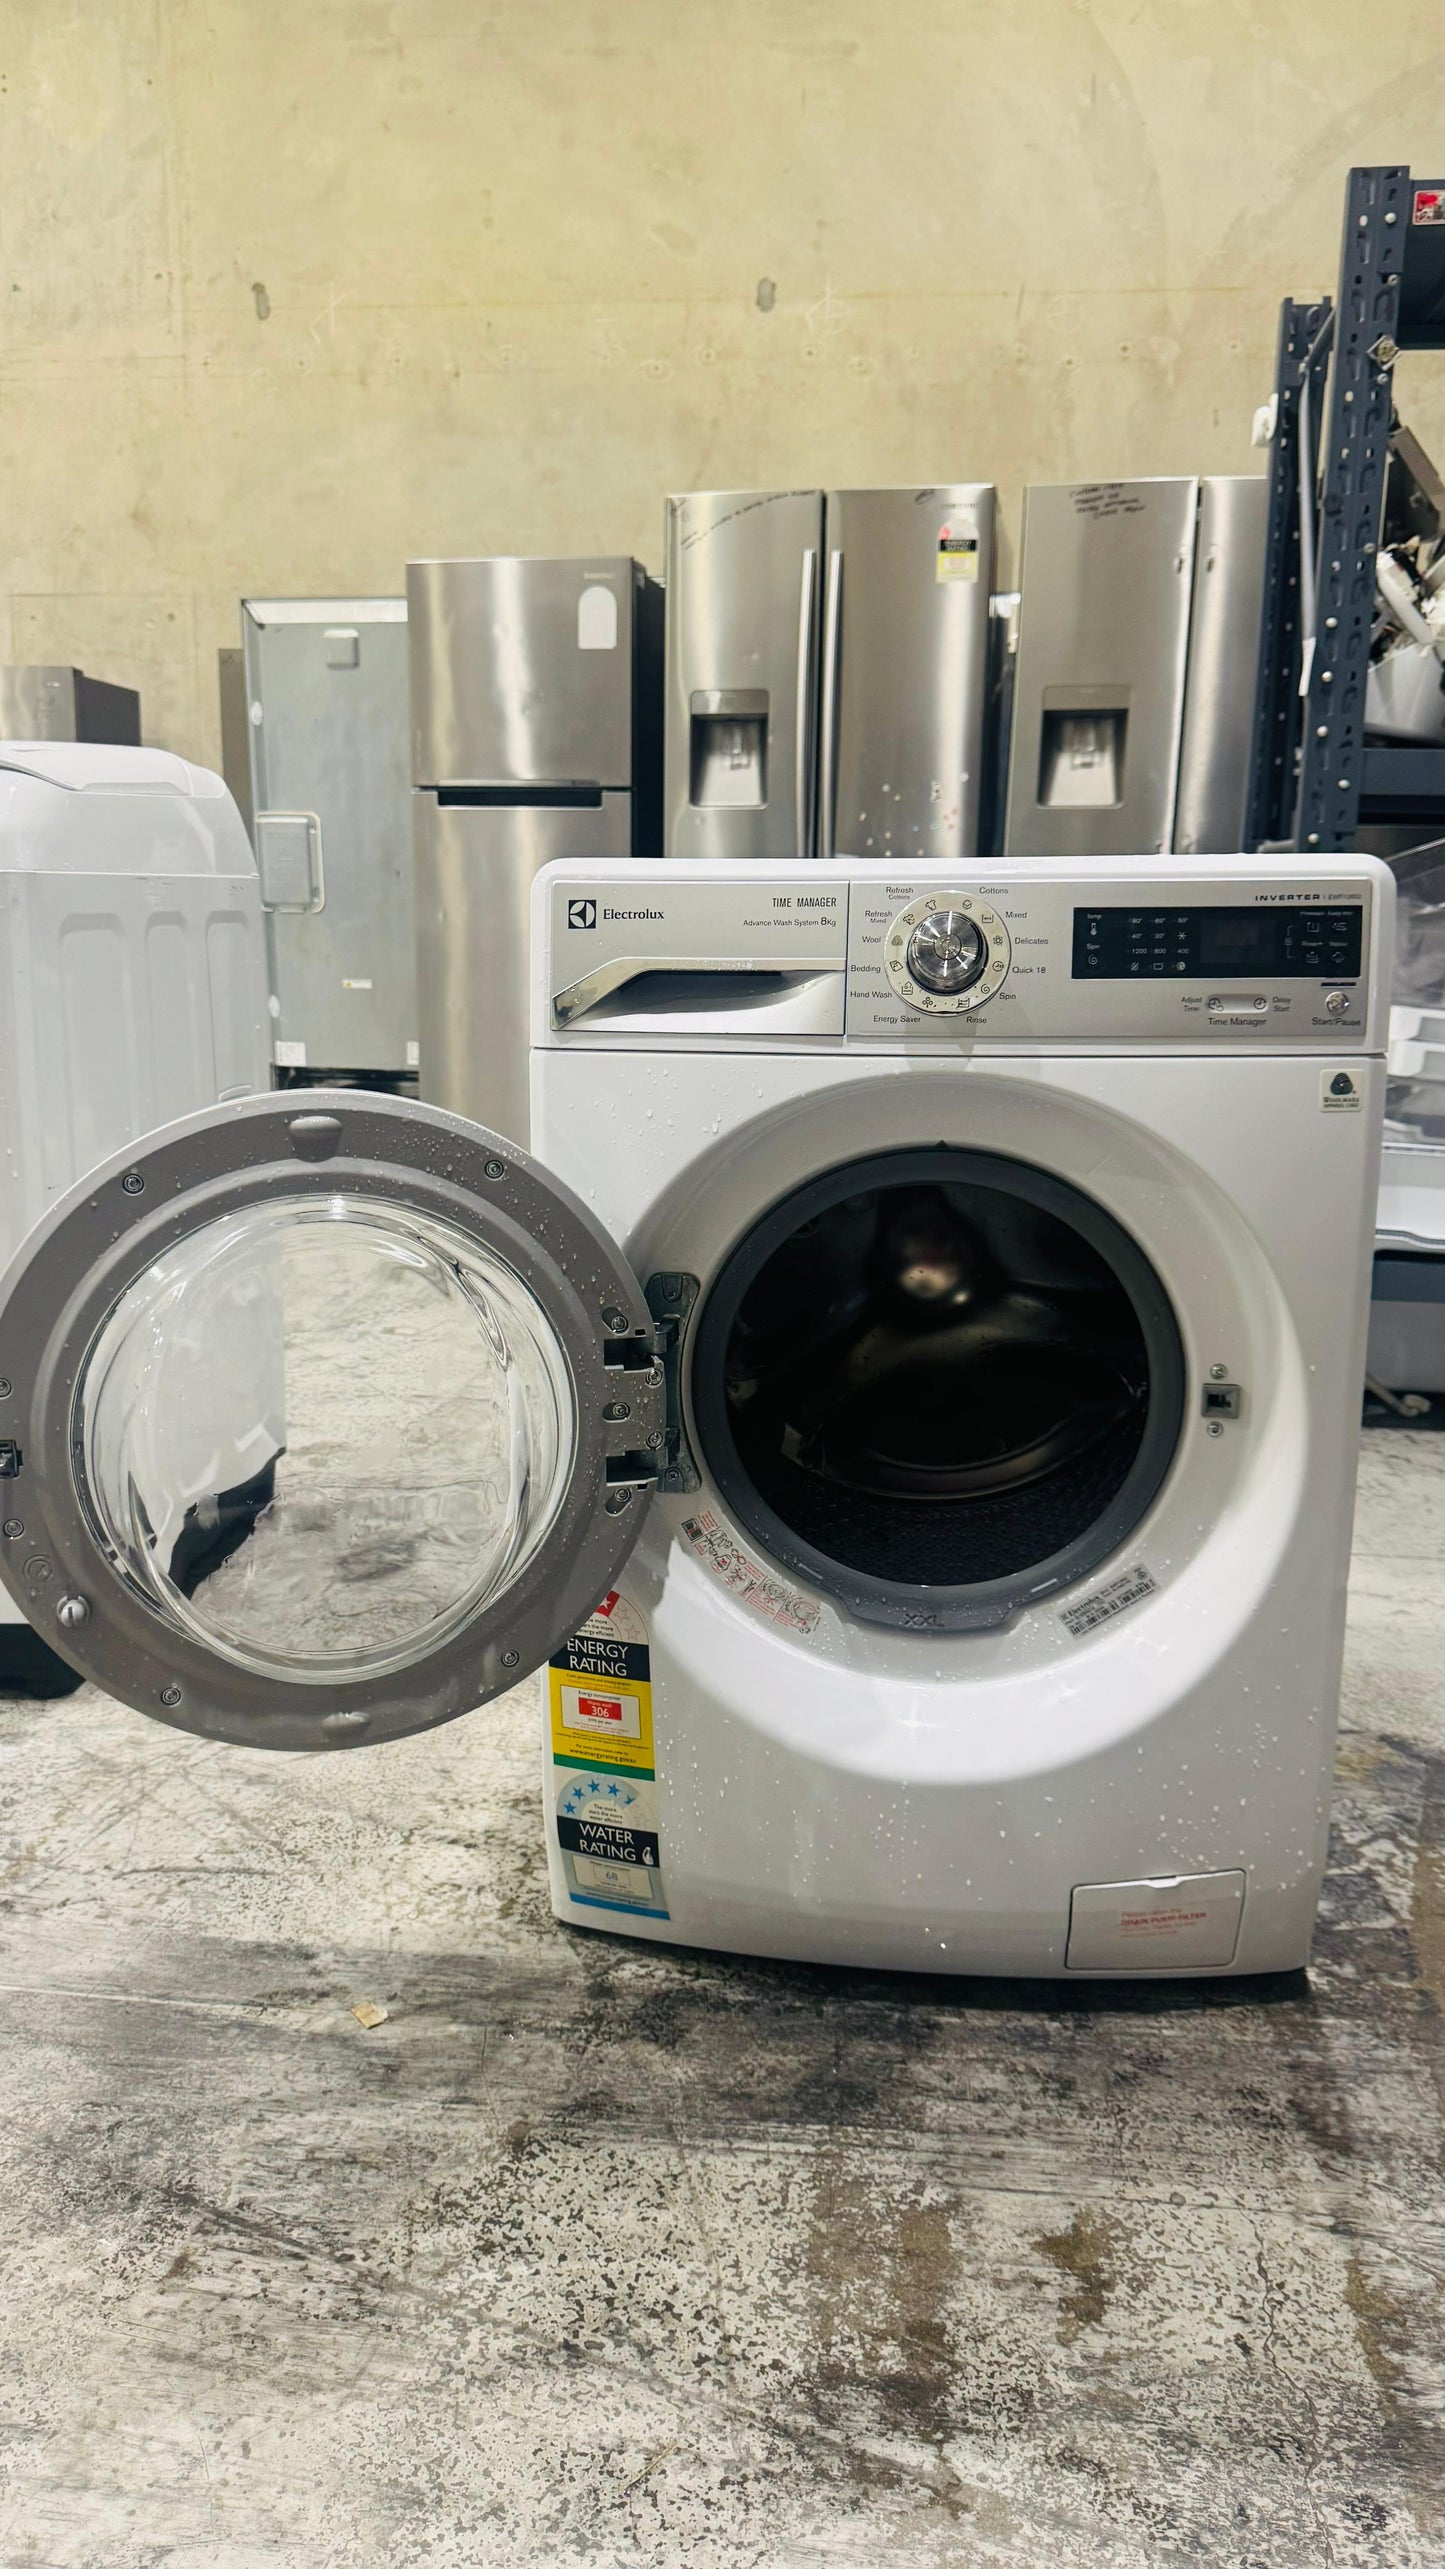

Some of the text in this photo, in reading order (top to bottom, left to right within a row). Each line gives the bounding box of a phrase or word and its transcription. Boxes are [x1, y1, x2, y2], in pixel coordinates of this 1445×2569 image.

[886, 886, 914, 894] Refresh
[1255, 893, 1320, 901] INVERTER
[772, 897, 837, 908] TIME MANAGER
[603, 908, 665, 920] Electrolux
[865, 910, 893, 918] Refresh
[1005, 911, 1027, 919] Mixed
[743, 919, 772, 927] Advance
[794, 918, 819, 928] System
[820, 916, 837, 927] 8Kg
[862, 936, 881, 944] Wool
[1014, 937, 1049, 945] Delicates
[850, 965, 881, 974] Bedding
[1012, 966, 1034, 974] Quick
[999, 993, 1017, 1001] Spin
[1181, 996, 1203, 1004] Adjust
[1272, 996, 1292, 1004] Delay
[873, 1015, 921, 1024] Energy Saver
[966, 1016, 988, 1024] Rinse
[1208, 1017, 1267, 1027] Time Manager
[1311, 1017, 1361, 1026] Start/Pause
[903, 1613, 946, 1628] XXL
[567, 1638, 629, 1659] ENERGY
[569, 1655, 627, 1677] RATING
[591, 1706, 610, 1718] 306
[579, 1822, 635, 1845] WATER
[579, 1839, 636, 1862] RATING
